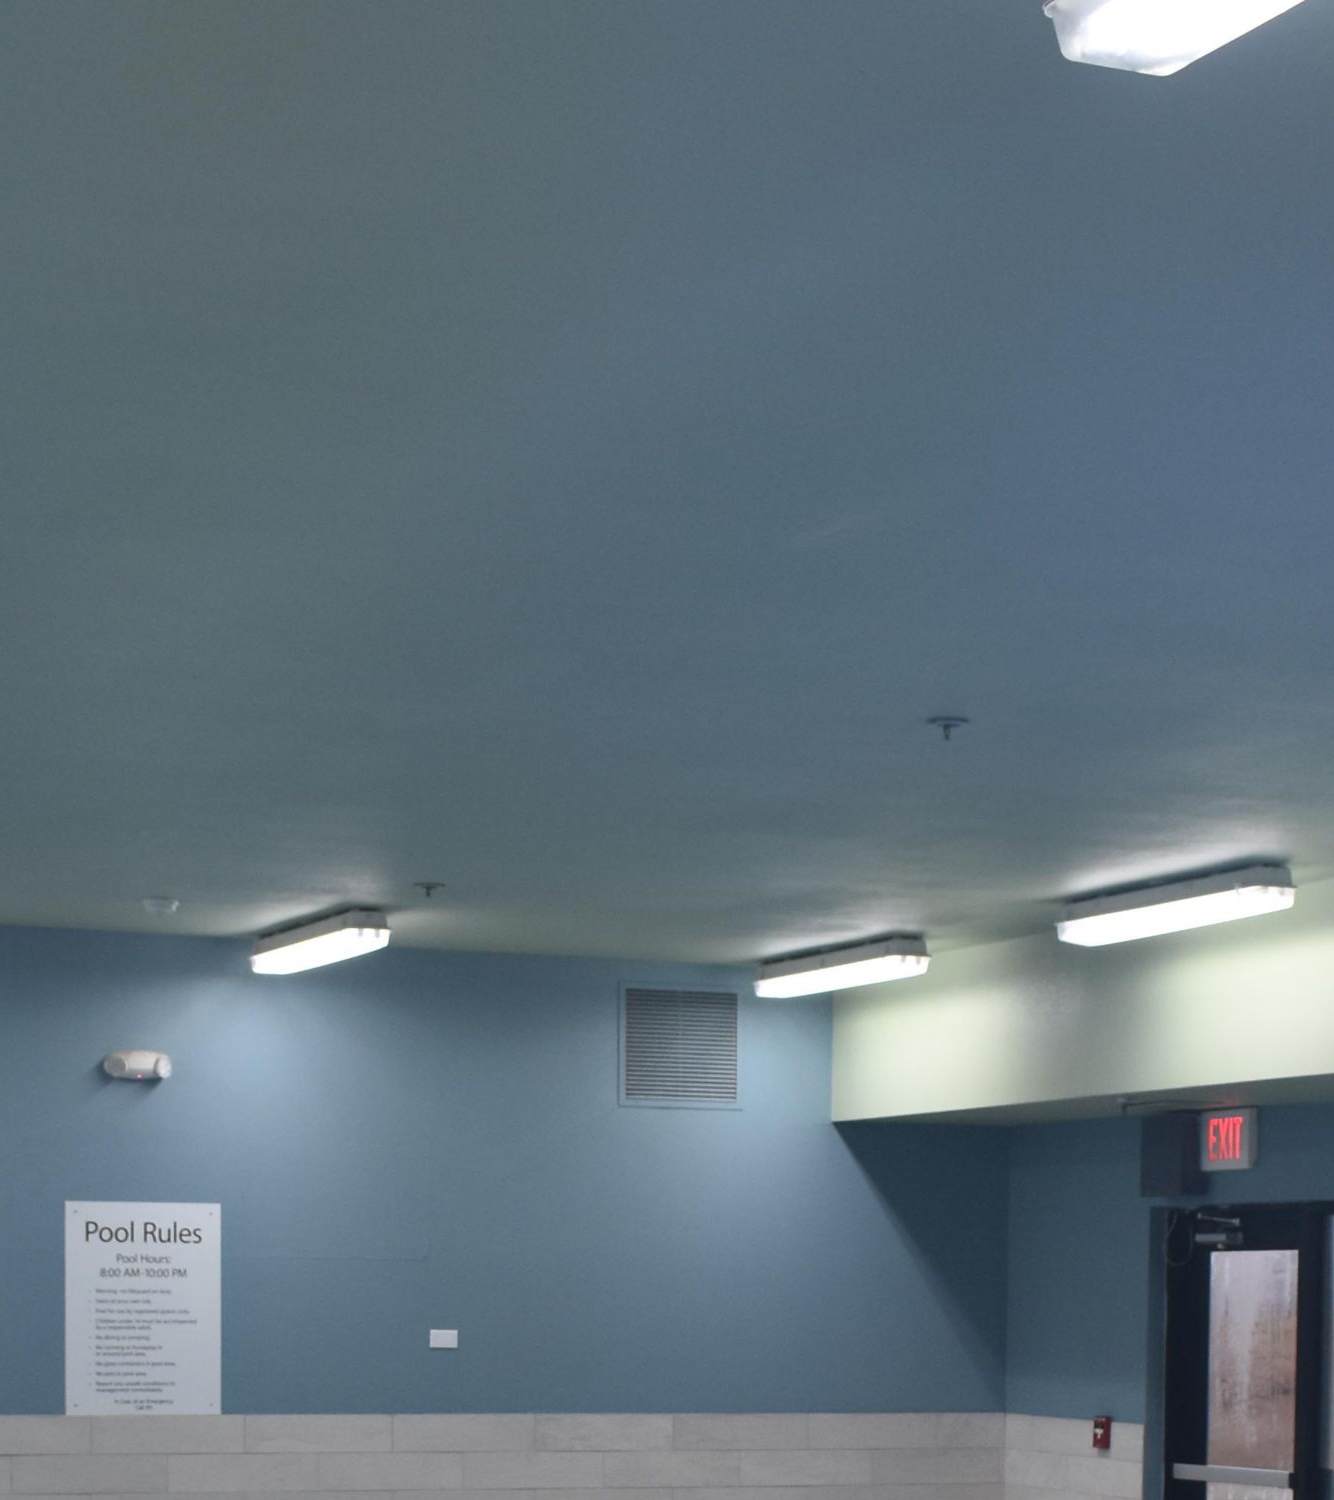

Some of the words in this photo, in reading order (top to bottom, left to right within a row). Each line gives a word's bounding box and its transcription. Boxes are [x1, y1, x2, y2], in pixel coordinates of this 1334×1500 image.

[1208, 1116, 1243, 1161] EXIT
[85, 1221, 135, 1243] Pool
[143, 1221, 203, 1244] Rules
[116, 1253, 138, 1264] Pool
[99, 1268, 121, 1278] 8:00
[171, 1268, 188, 1278] PM
